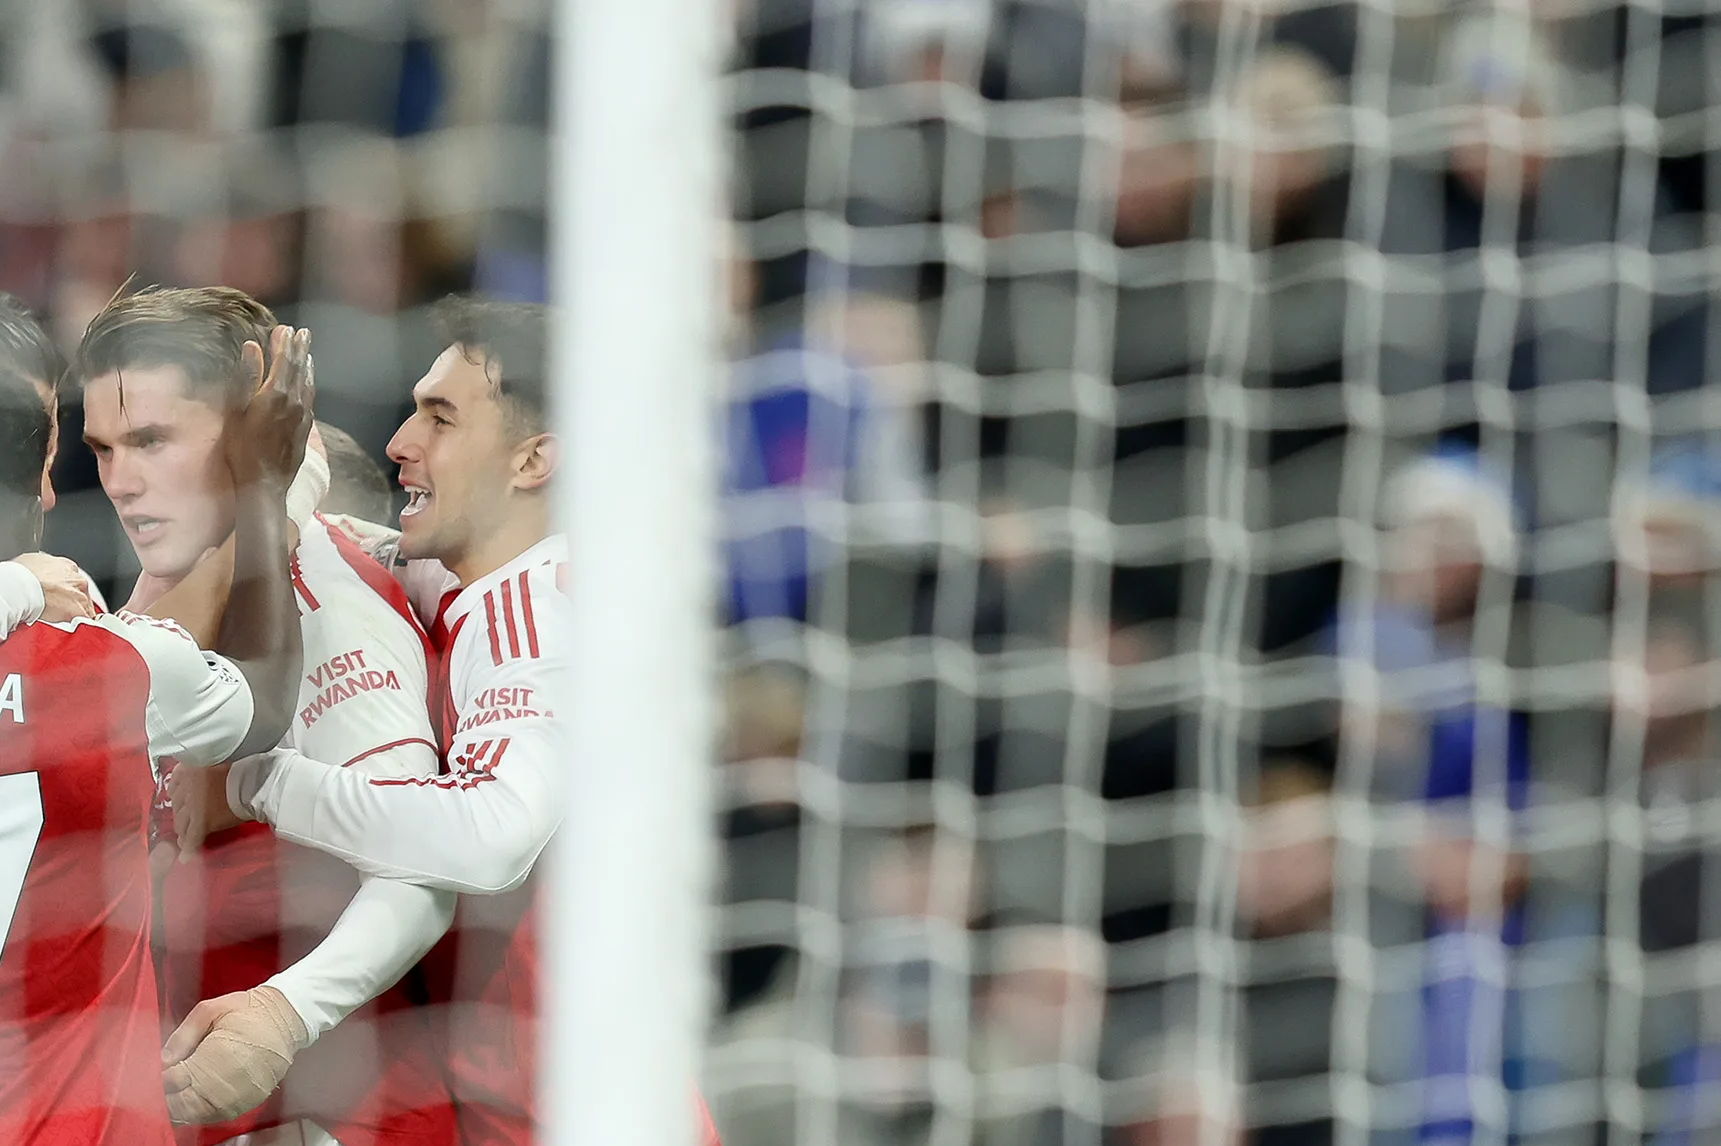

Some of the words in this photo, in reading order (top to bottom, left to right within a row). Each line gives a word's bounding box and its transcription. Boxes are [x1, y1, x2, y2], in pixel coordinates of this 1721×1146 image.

[306, 649, 367, 689] VISIT
[299, 670, 401, 729] RWANDA
[474, 687, 534, 710] VISIT
